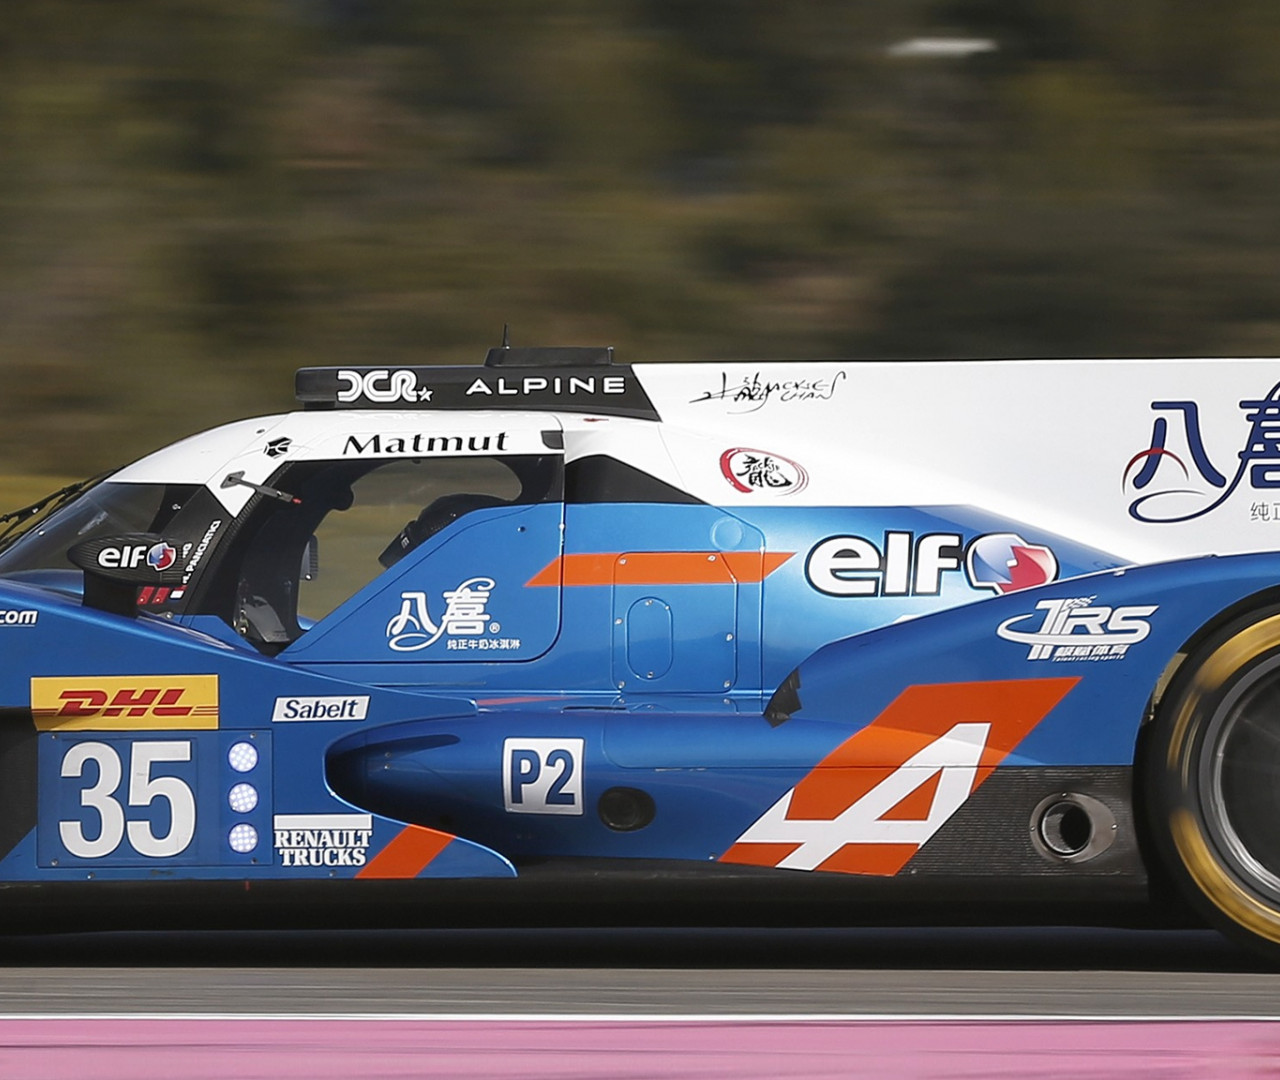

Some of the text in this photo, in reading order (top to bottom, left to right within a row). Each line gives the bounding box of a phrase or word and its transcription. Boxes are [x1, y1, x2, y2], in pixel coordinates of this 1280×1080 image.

[464, 376, 627, 396] ALPINE
[342, 431, 510, 456] Matmut
[97, 545, 147, 568] elf
[806, 529, 963, 597] elf
[386, 576, 496, 652] 八喜
[56, 688, 195, 717] DHL
[282, 699, 359, 719] Sabelt
[511, 749, 576, 806] P2
[59, 741, 197, 858] 35
[273, 829, 373, 848] RENAULT
[278, 848, 367, 867] TRUCKS
